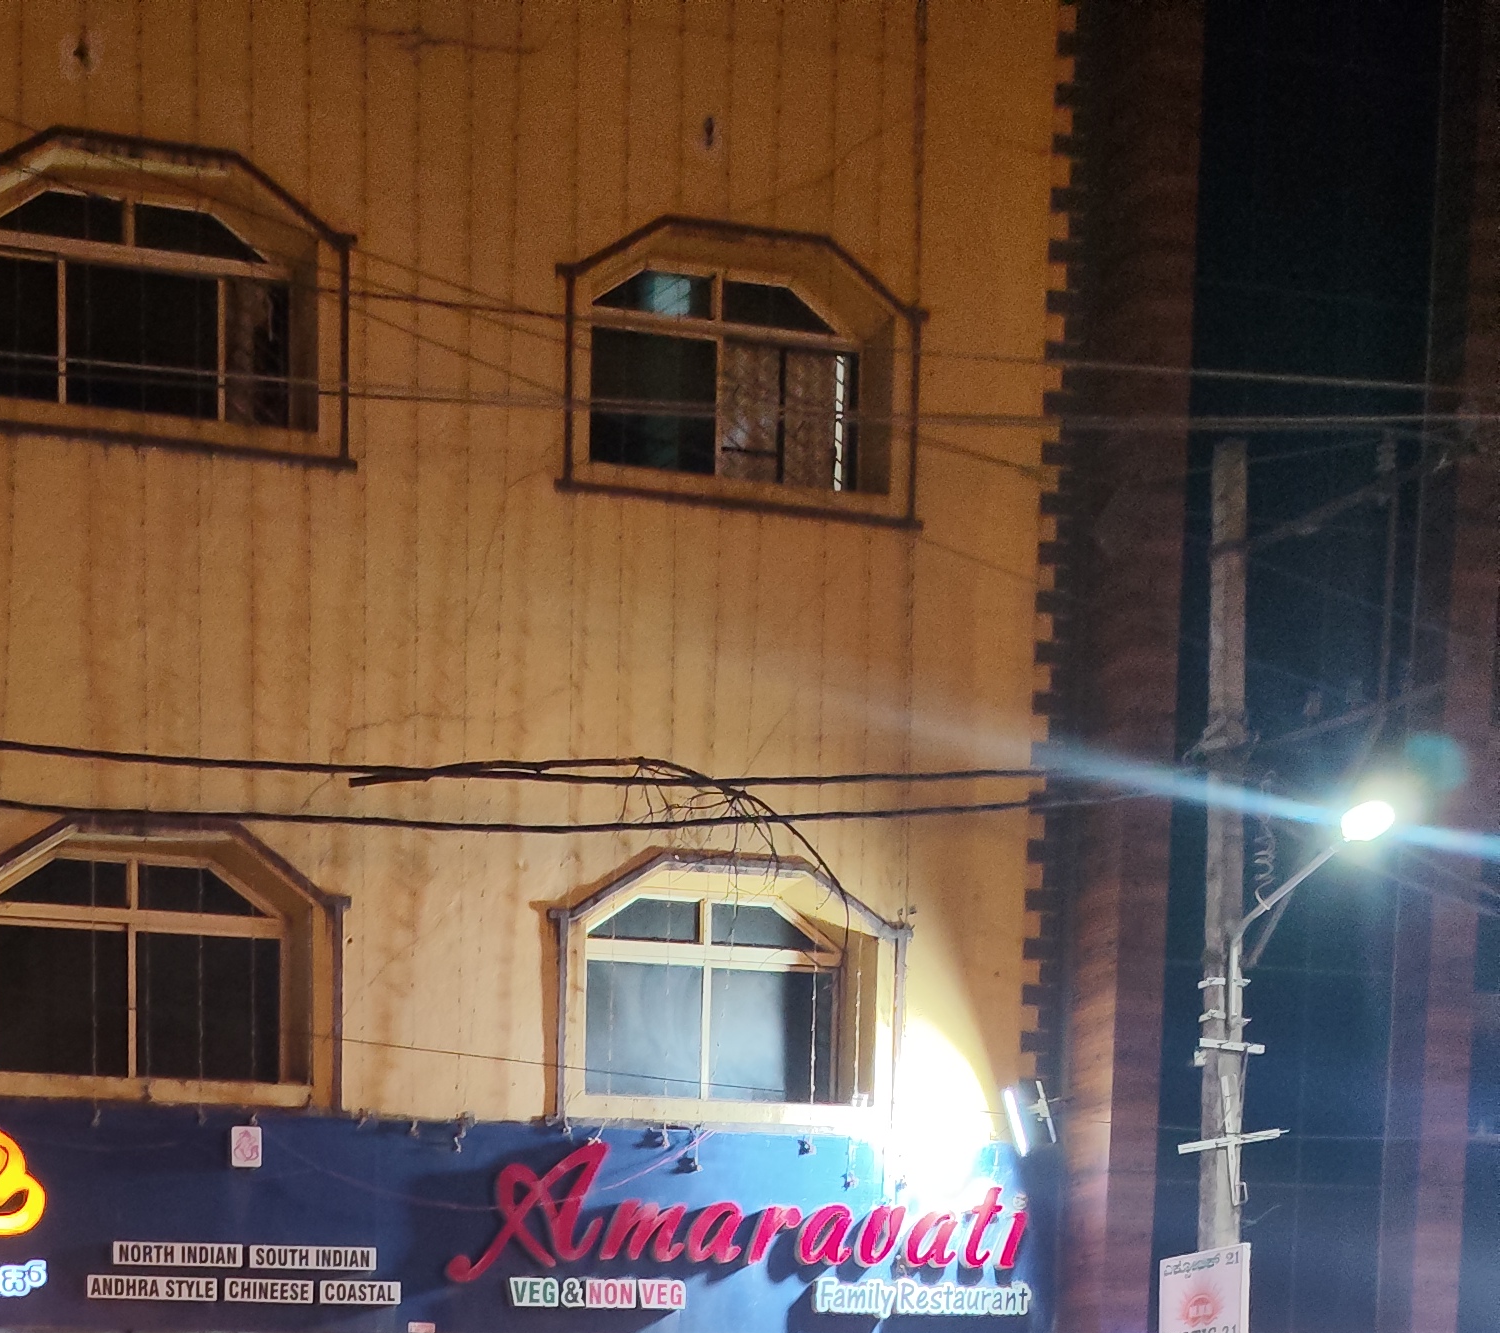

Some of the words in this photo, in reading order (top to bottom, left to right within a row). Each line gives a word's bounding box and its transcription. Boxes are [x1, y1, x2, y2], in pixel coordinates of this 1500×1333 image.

[445, 1141, 1027, 1283] Amaravati
[118, 1244, 175, 1264] NORTH
[181, 1246, 238, 1266] INDIAN
[255, 1248, 310, 1267] SOUTH
[315, 1249, 371, 1268] INDIAN
[90, 1277, 160, 1298] ANDHRA
[165, 1279, 215, 1299] STYLE
[228, 1281, 310, 1301] CHINEESE
[324, 1283, 396, 1302] COASTAL
[513, 1280, 556, 1304] VEG
[563, 1280, 581, 1304] &
[588, 1282, 633, 1306] NON
[641, 1283, 683, 1306] VEG
[818, 1279, 895, 1316] Family
[898, 1280, 1030, 1313] Restaurant
